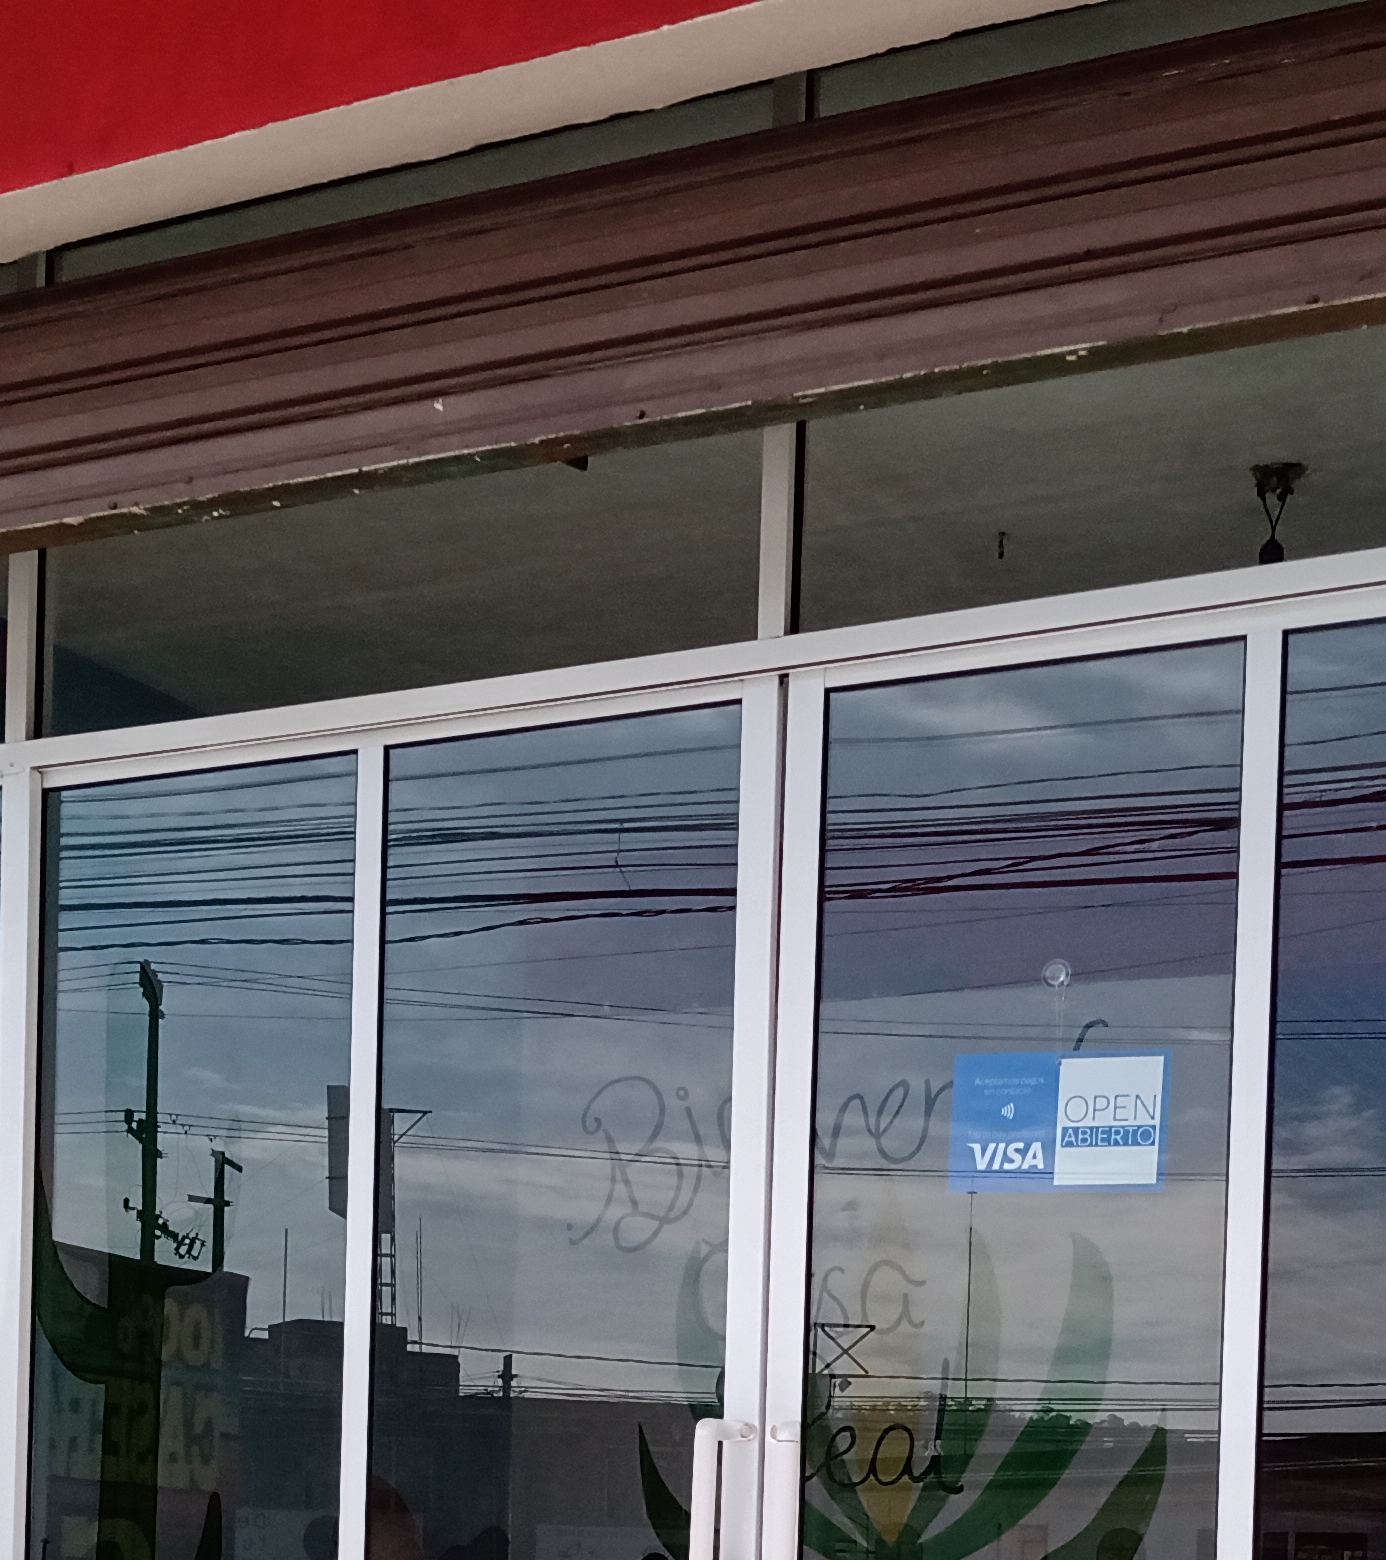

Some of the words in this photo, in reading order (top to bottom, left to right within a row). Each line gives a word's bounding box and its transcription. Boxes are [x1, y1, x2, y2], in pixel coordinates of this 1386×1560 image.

[1064, 1094, 1157, 1123] OPEN
[1063, 1126, 1155, 1146] ABIERTO
[967, 1142, 1045, 1171] VISA
